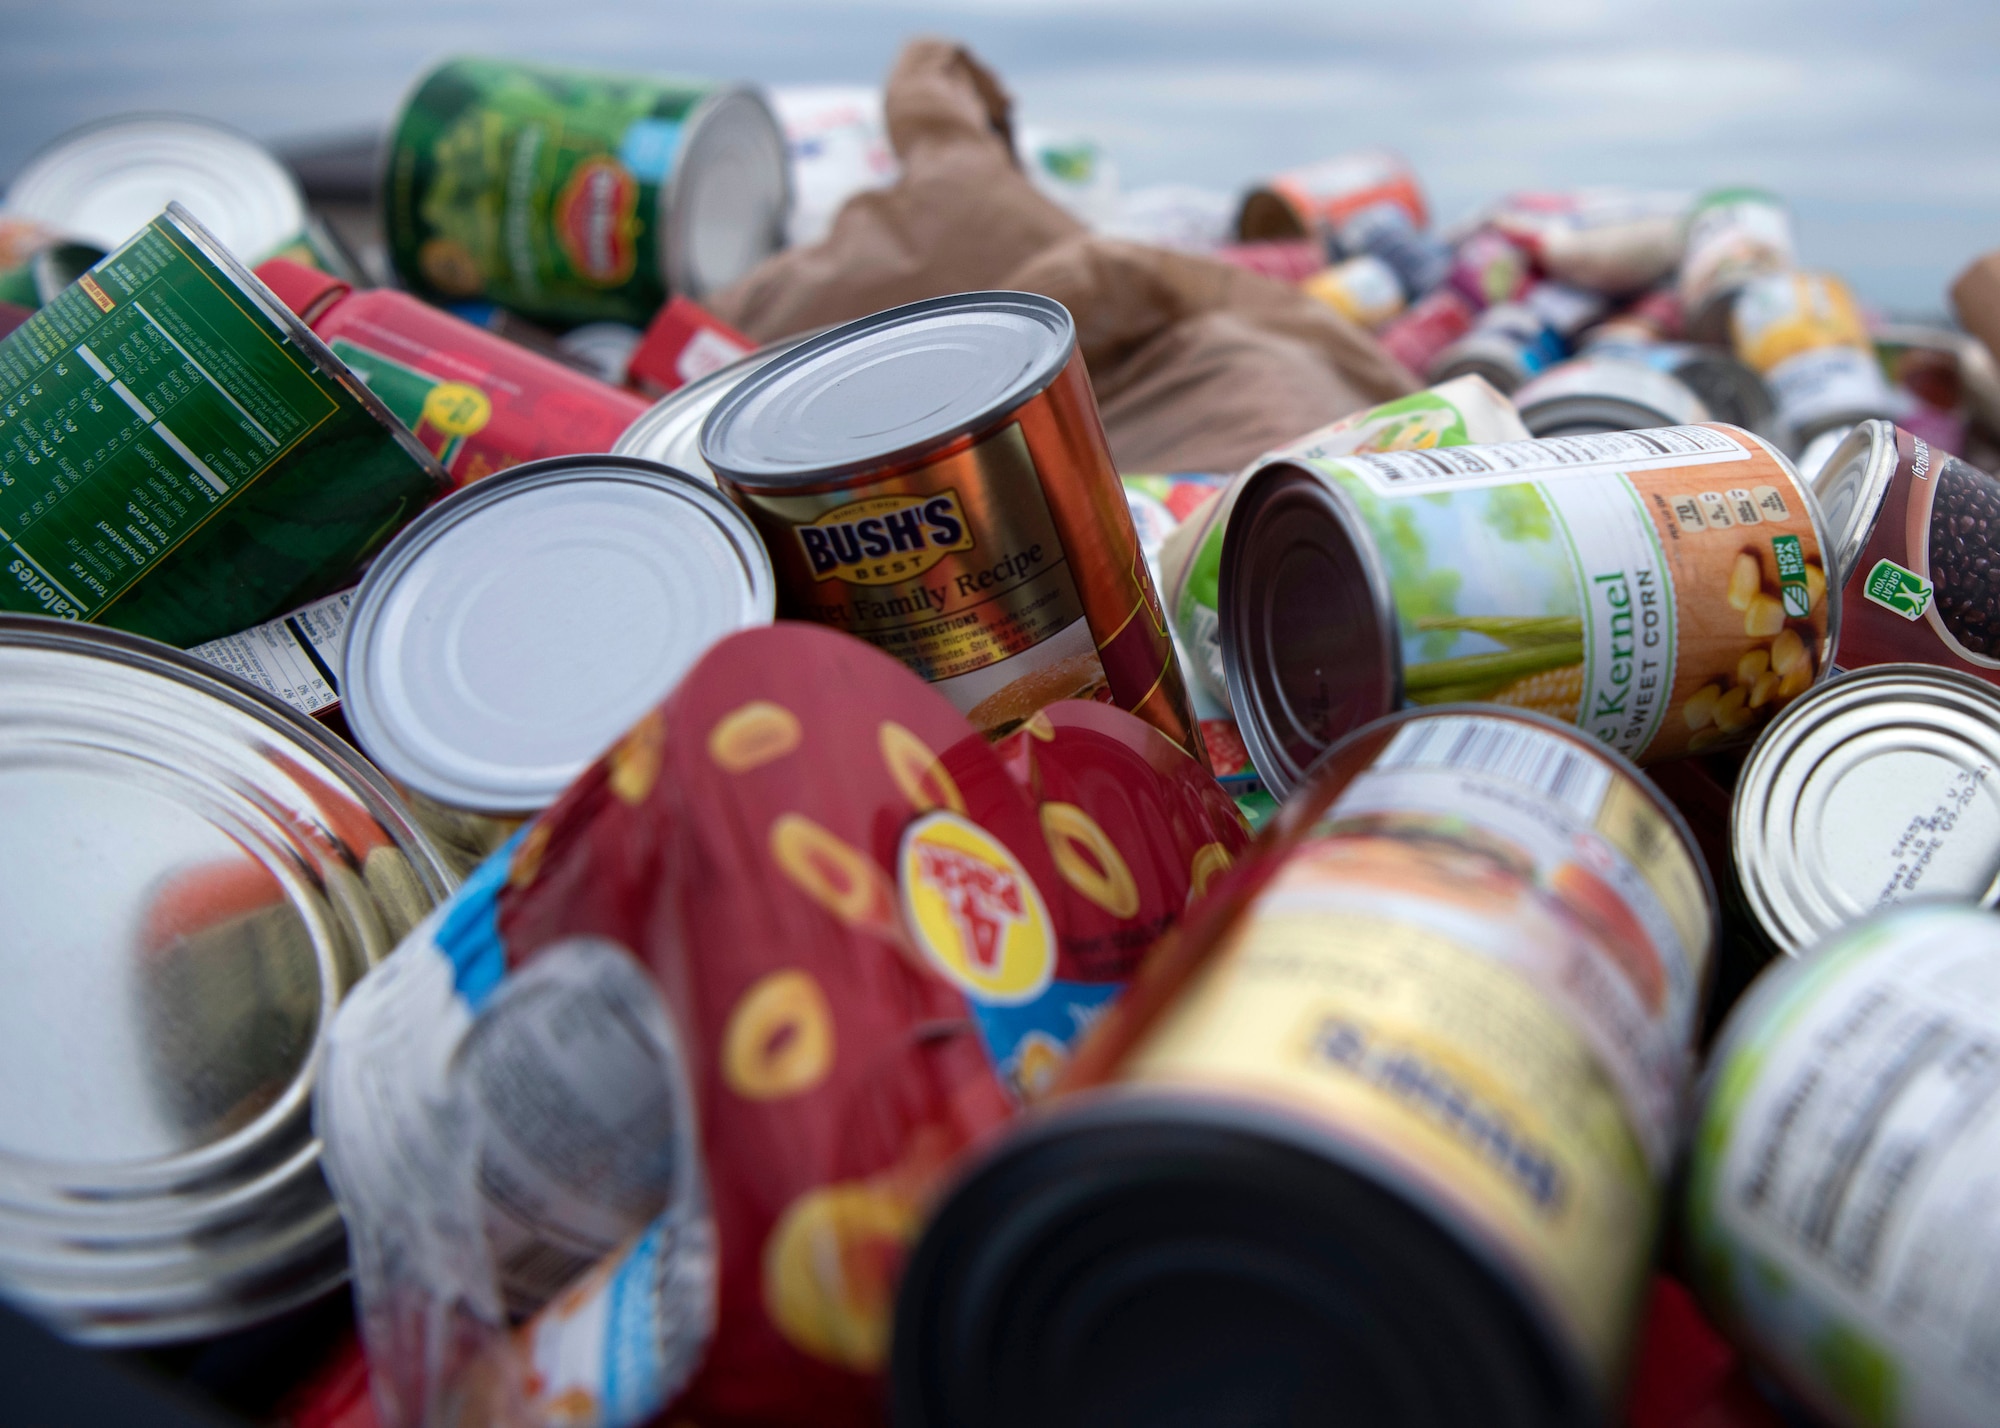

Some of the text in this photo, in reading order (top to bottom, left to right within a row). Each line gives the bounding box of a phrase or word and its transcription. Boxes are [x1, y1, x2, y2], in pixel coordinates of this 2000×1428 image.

[88, 335, 238, 486] Vitamin D 0mcg 0% 0mcg 0%
[100, 325, 251, 475] Calcium 32mg 2% 22mg 2%
[113, 315, 263, 465] Iron 0.5mg 2% 0.3mg 2%
[125, 305, 275, 455] Potassium 95mg 2% 53mg 2%
[225, 366, 256, 396] contributes
[226, 380, 241, 395] (DV)
[238, 392, 255, 410] Value
[253, 406, 269, 423] Daily
[29, 382, 176, 528] Dietary Fiber 1g 4% 1g 4%
[54, 362, 182, 488] Added Sugars 0g 0% 0g 0%
[67, 397, 188, 518] Total Sugars 1g 1g
[92, 376, 219, 503] Protein 1g 1g
[271, 410, 293, 432] serving
[4, 403, 158, 554] Sodium 380mg 17% 200mg 9%
[12, 434, 145, 565] Cholesterol 0mg 0% 0mg
[16, 393, 169, 544] Total Carb. 3g 1% 2g 1%
[1908, 452, 1929, 480] (432g)
[0, 470, 115, 581] Saturated Fat 0g 0%
[4, 449, 127, 570] Trans Fat 0g 0g
[801, 499, 961, 576] BUSH'S
[1675, 504, 1694, 522] 70
[18, 511, 108, 597] Total Fat 0g
[854, 555, 921, 583] BEST
[854, 543, 1045, 624] Family Recipe
[1774, 542, 1789, 575] NON
[1783, 542, 1798, 573] BPA
[1871, 566, 1892, 595] FOR YOU
[1880, 570, 1901, 600] GREAT
[296, 610, 319, 636] Protein
[908, 611, 978, 646] DIRECTIONS
[923, 641, 968, 669] minutes.
[969, 638, 988, 652] Stir
[988, 627, 1010, 644] and
[940, 612, 1018, 649] microwave-safe
[947, 648, 997, 675] saucepan.
[1595, 571, 1635, 717] Kernel
[1624, 569, 1661, 738] SWEET CORN
